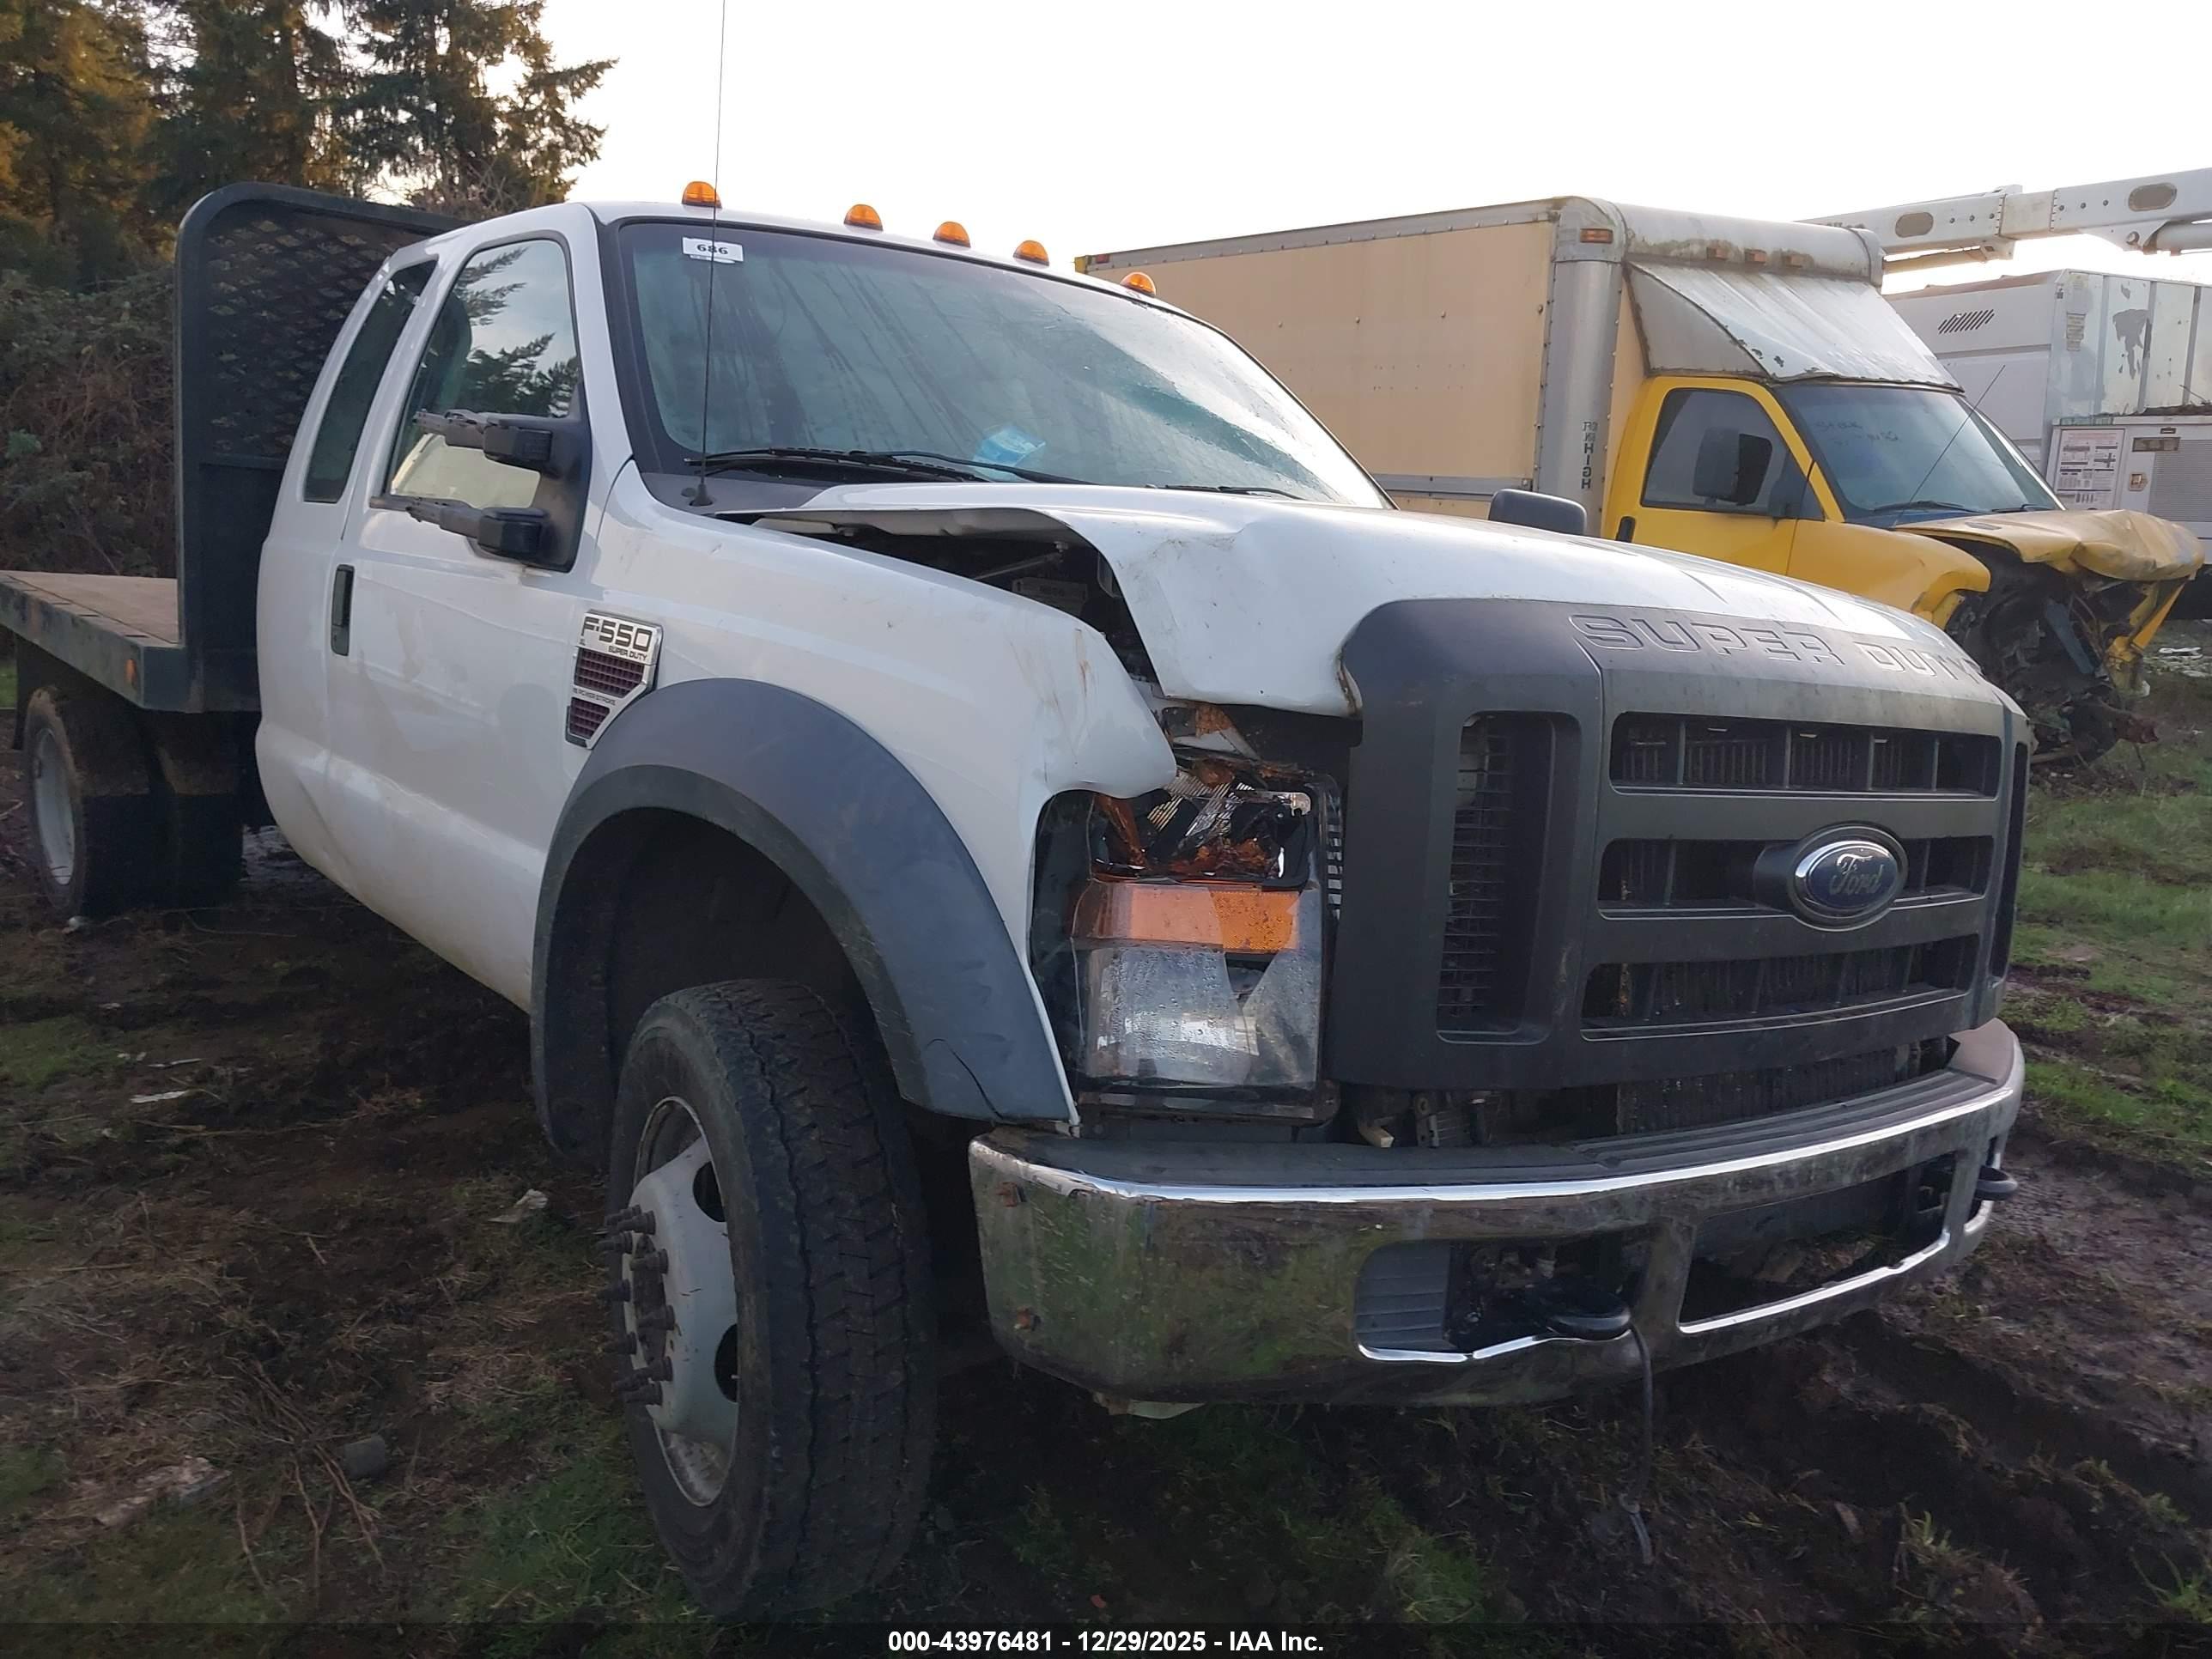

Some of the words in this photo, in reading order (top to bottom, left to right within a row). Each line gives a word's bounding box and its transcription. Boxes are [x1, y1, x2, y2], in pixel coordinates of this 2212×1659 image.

[696, 244, 729, 255] 686
[580, 616, 653, 653] F-550
[1569, 614, 1846, 666] SUPER
[1852, 641, 1985, 684] DUTY
[608, 646, 629, 658] SUPER
[629, 651, 647, 661] DUTY
[1829, 853, 1885, 895] Ford
